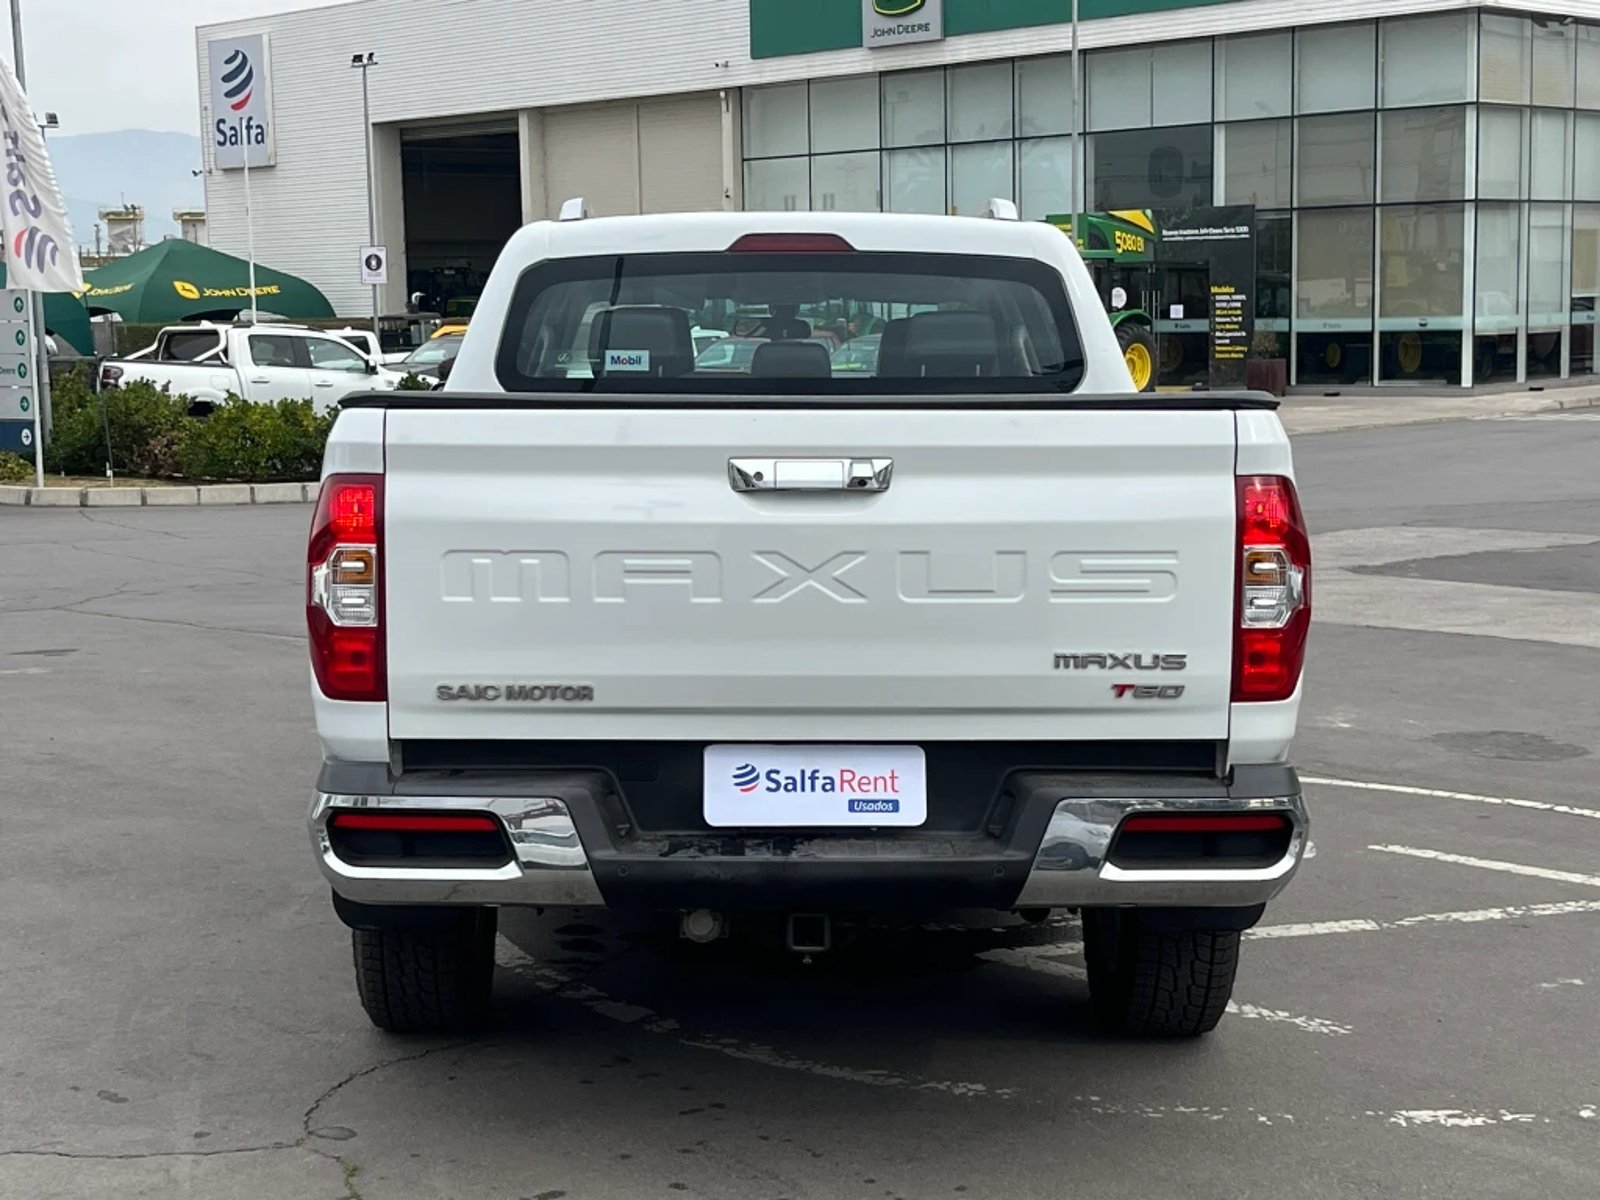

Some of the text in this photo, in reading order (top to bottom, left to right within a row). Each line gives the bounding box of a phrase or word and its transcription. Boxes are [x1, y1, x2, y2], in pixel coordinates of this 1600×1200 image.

[870, 22, 931, 38] JOHN DEERE
[216, 116, 265, 147] Salfa
[202, 287, 237, 296] JOHN
[610, 355, 642, 366] Mobil
[441, 550, 1179, 604] MAXUS
[1053, 653, 1187, 670] MAXUS
[436, 685, 594, 701] SAIC MOTOR
[1111, 684, 1185, 699] T60
[854, 801, 894, 812] Usados
